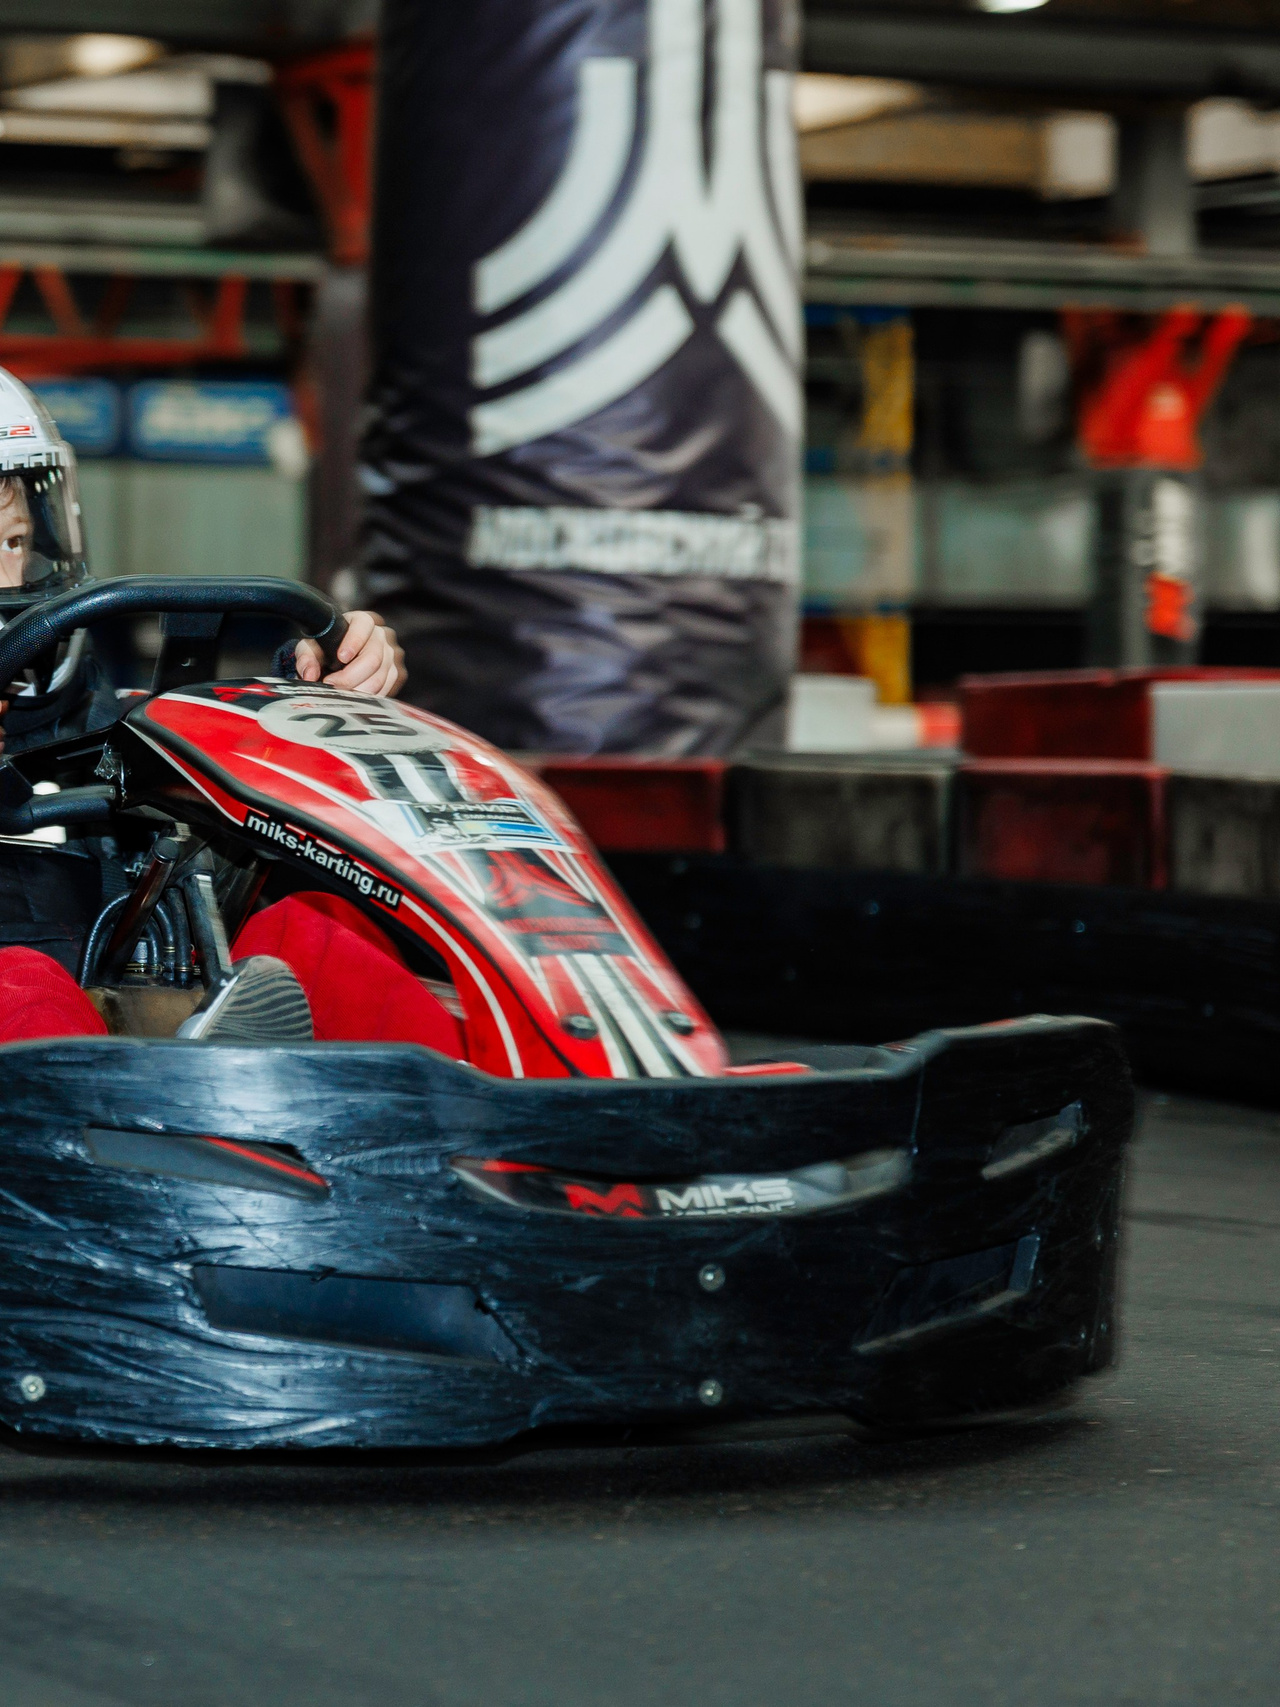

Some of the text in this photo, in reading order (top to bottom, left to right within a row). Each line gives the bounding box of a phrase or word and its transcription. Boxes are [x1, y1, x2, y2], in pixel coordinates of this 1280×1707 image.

[287, 713, 418, 738] 25
[247, 815, 399, 906] miks-karting.ru
[656, 1179, 793, 1211] MIKS
